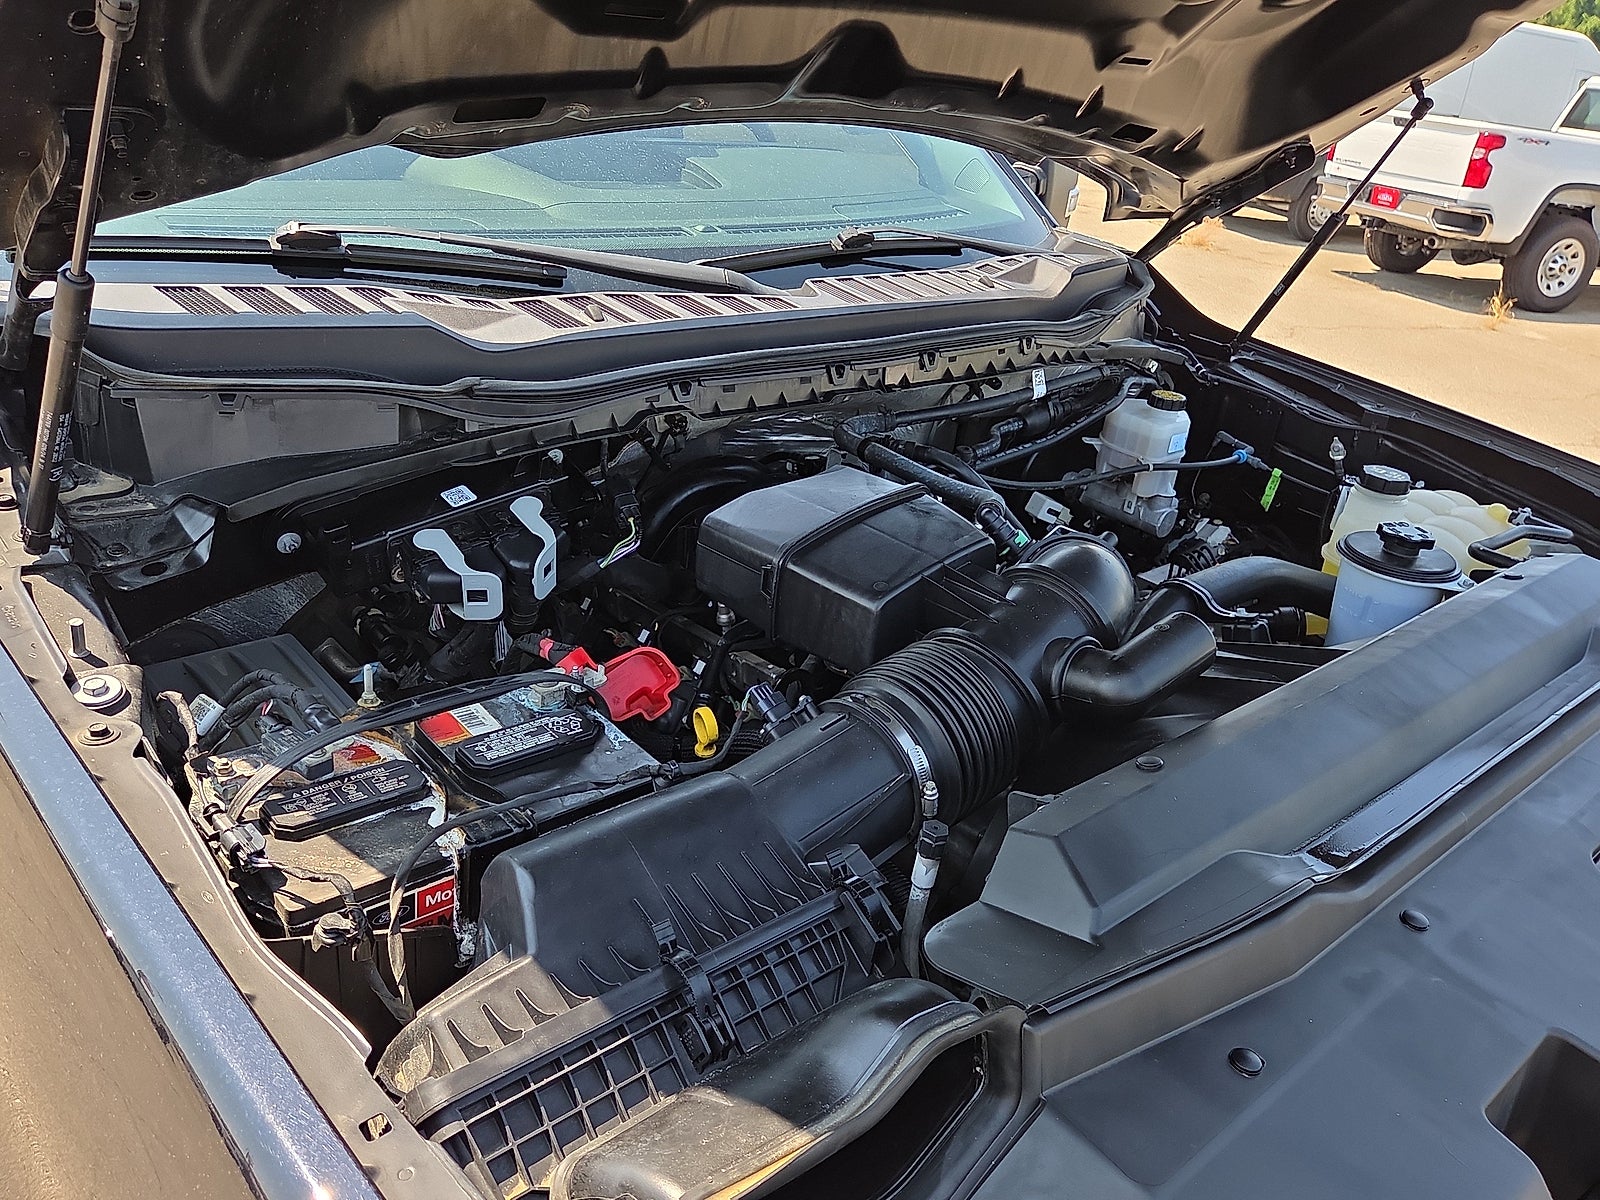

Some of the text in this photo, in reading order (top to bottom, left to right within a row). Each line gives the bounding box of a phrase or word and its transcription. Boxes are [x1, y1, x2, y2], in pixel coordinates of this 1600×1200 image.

[301, 780, 342, 796] DANGER
[350, 767, 386, 780] POISON
[425, 888, 456, 908] Mo
